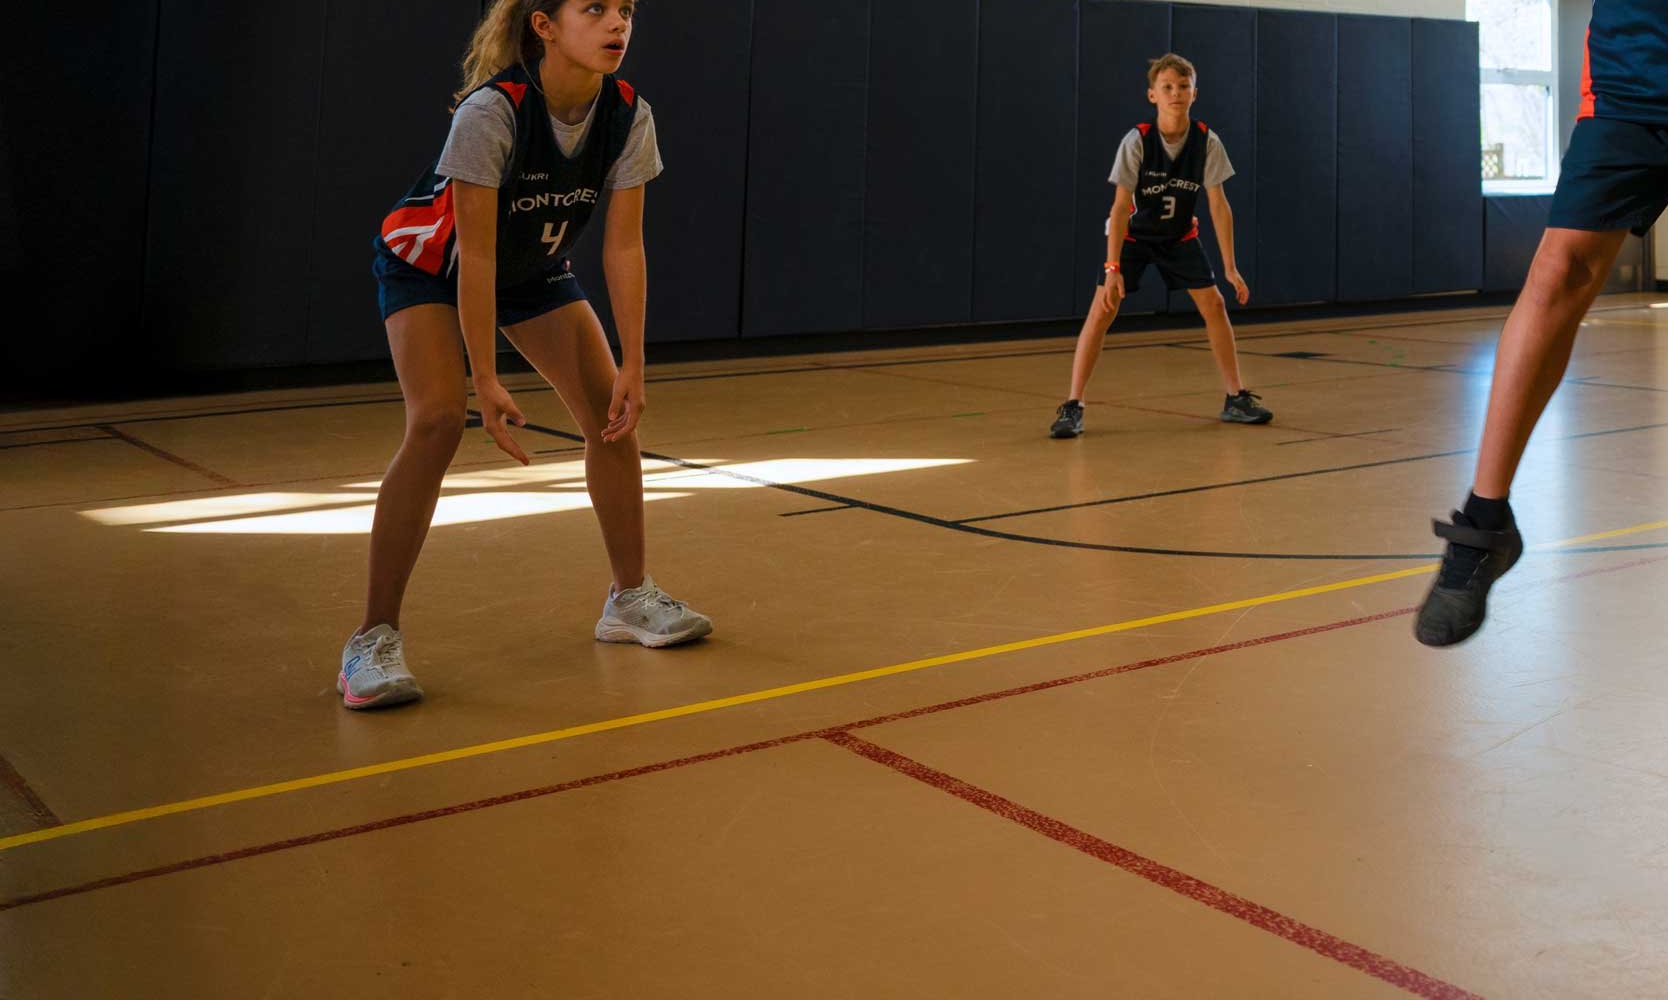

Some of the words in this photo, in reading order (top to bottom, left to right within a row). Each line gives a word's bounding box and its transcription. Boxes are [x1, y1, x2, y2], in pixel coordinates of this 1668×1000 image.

[1142, 178, 1200, 196] MONCREST
[1160, 196, 1176, 219] 3
[541, 220, 568, 256] 4
